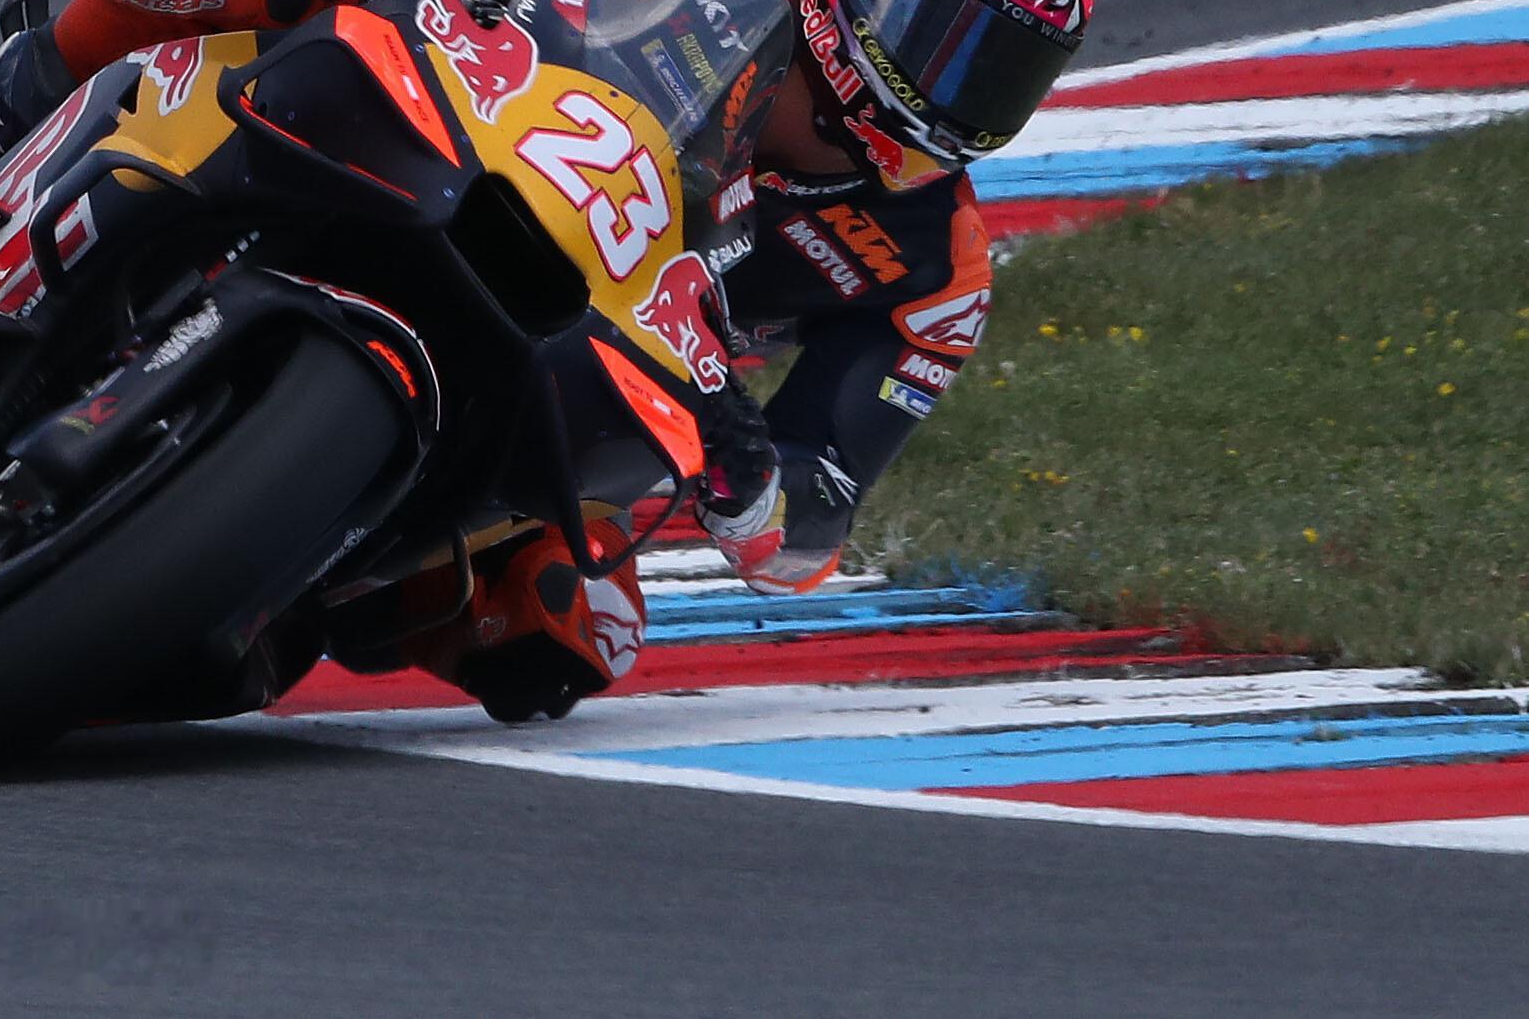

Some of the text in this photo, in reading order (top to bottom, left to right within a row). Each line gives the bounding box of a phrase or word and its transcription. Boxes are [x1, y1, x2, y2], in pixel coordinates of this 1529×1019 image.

[514, 90, 671, 281] 23
[783, 219, 863, 296] MOTUL
[815, 203, 910, 284] KTM
[900, 354, 958, 391] MOT
